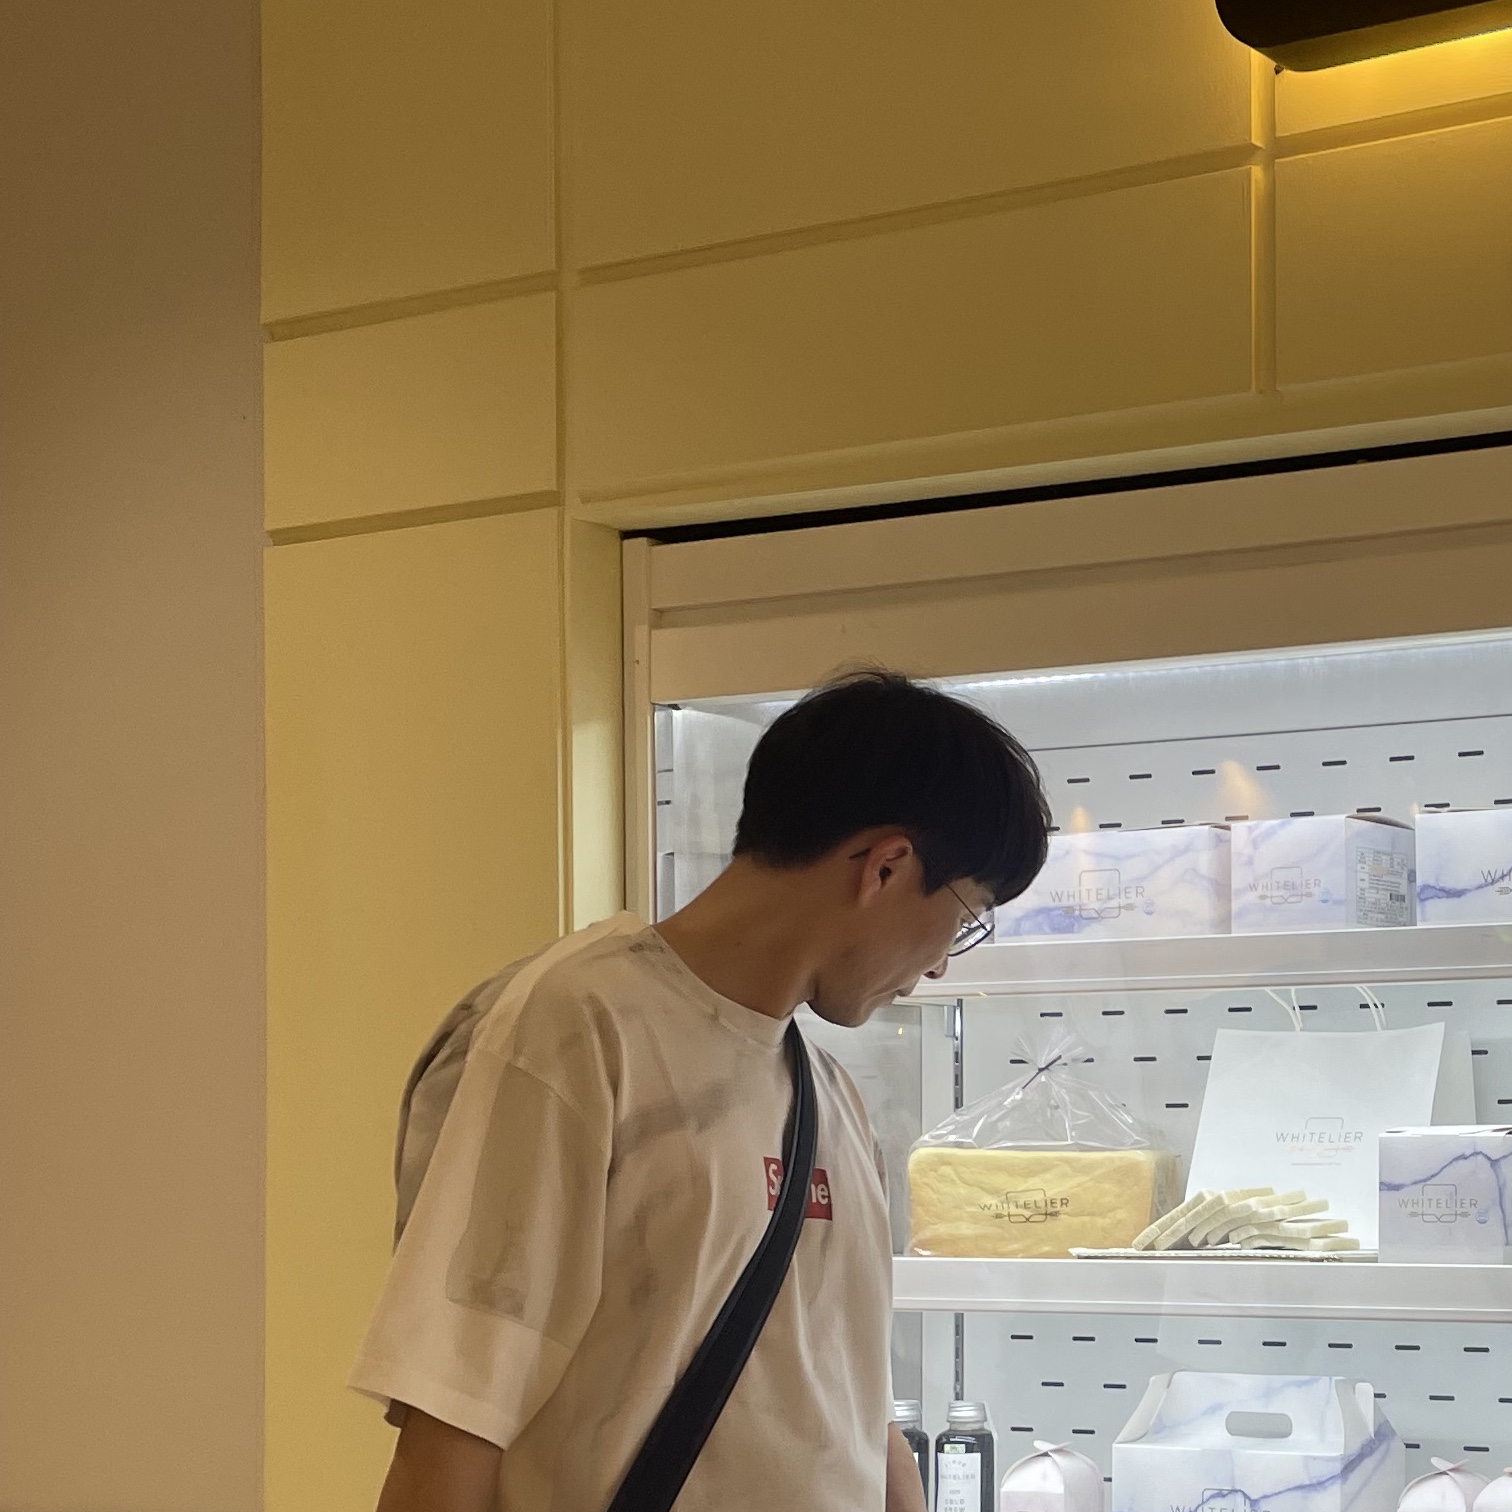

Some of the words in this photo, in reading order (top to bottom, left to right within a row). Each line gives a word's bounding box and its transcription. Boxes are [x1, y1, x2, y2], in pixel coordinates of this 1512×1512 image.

[1248, 877, 1322, 894] WHITELIER
[1049, 885, 1146, 904] WHITELIER
[1275, 1131, 1364, 1144] WHITELIER
[1397, 1198, 1479, 1210] WHITELIER
